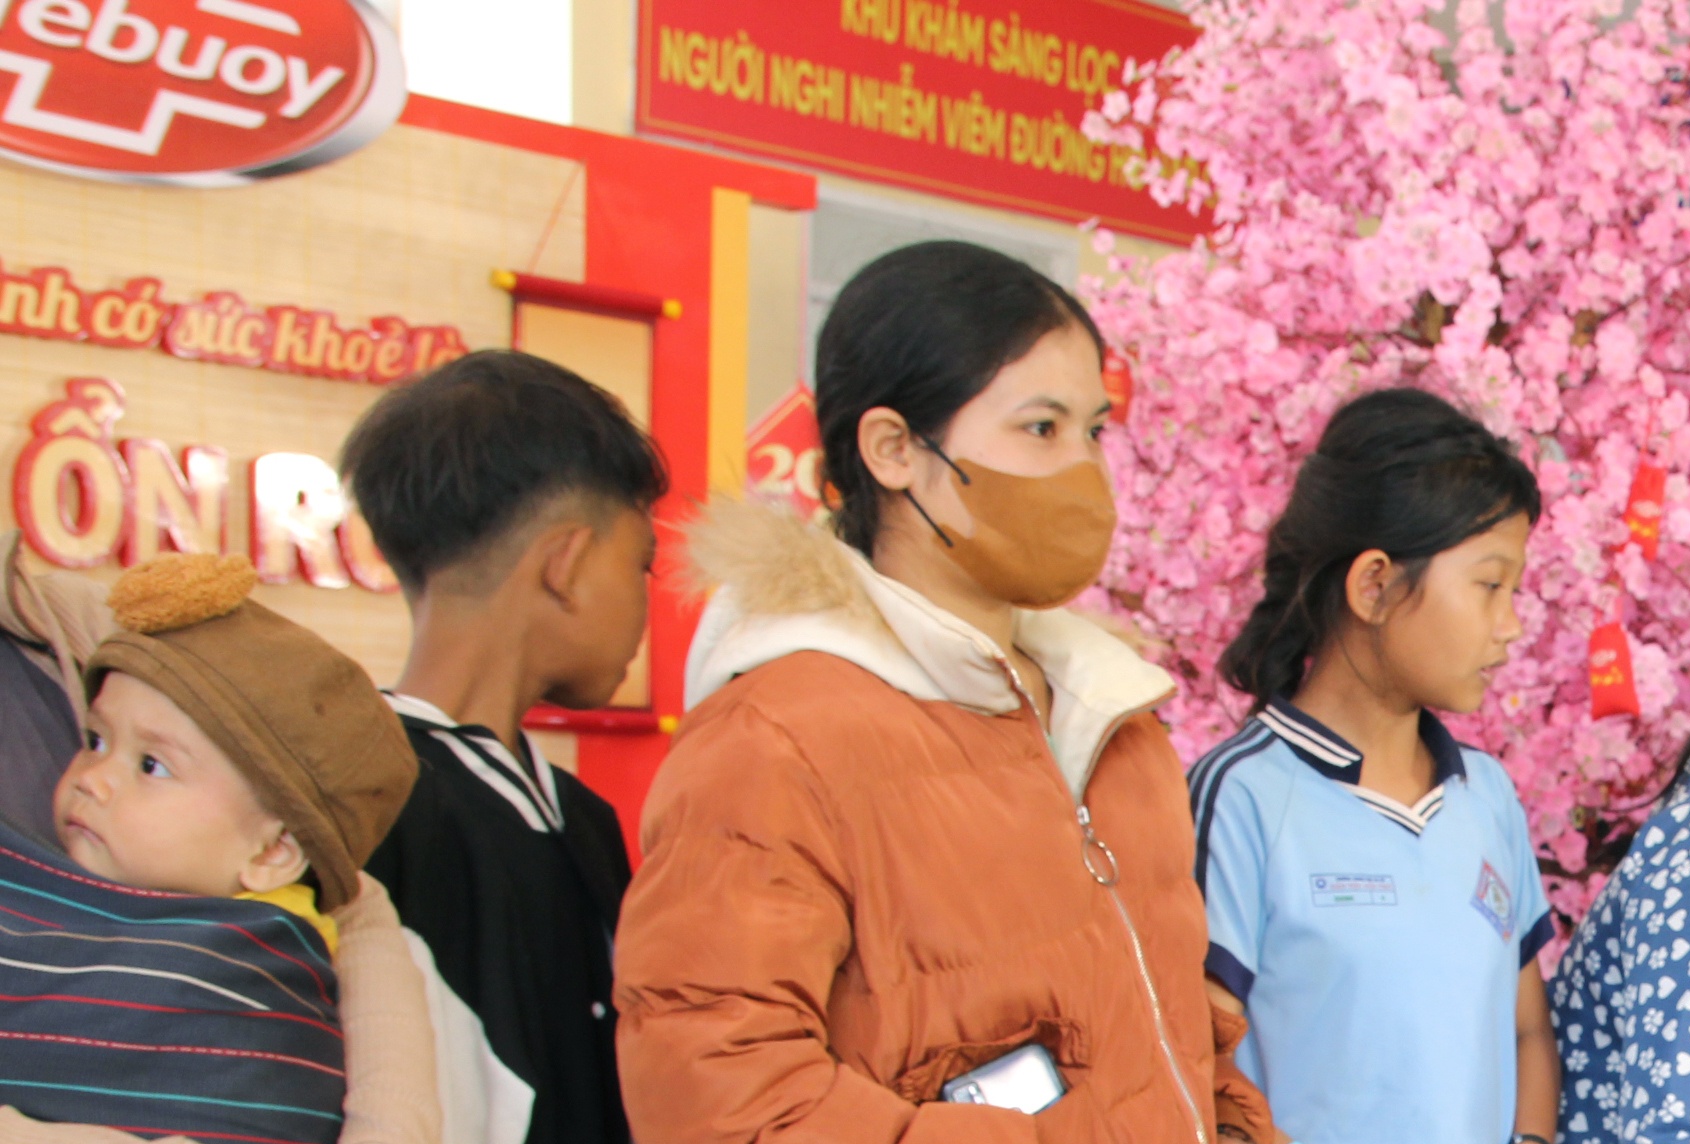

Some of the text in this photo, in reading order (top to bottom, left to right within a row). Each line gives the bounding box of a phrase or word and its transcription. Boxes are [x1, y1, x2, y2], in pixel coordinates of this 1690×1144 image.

[769, 53, 846, 123] NGHI
[1066, 40, 1120, 108] LỌC
[0, 267, 82, 338] nh
[92, 280, 162, 344] có
[177, 295, 268, 362] sức
